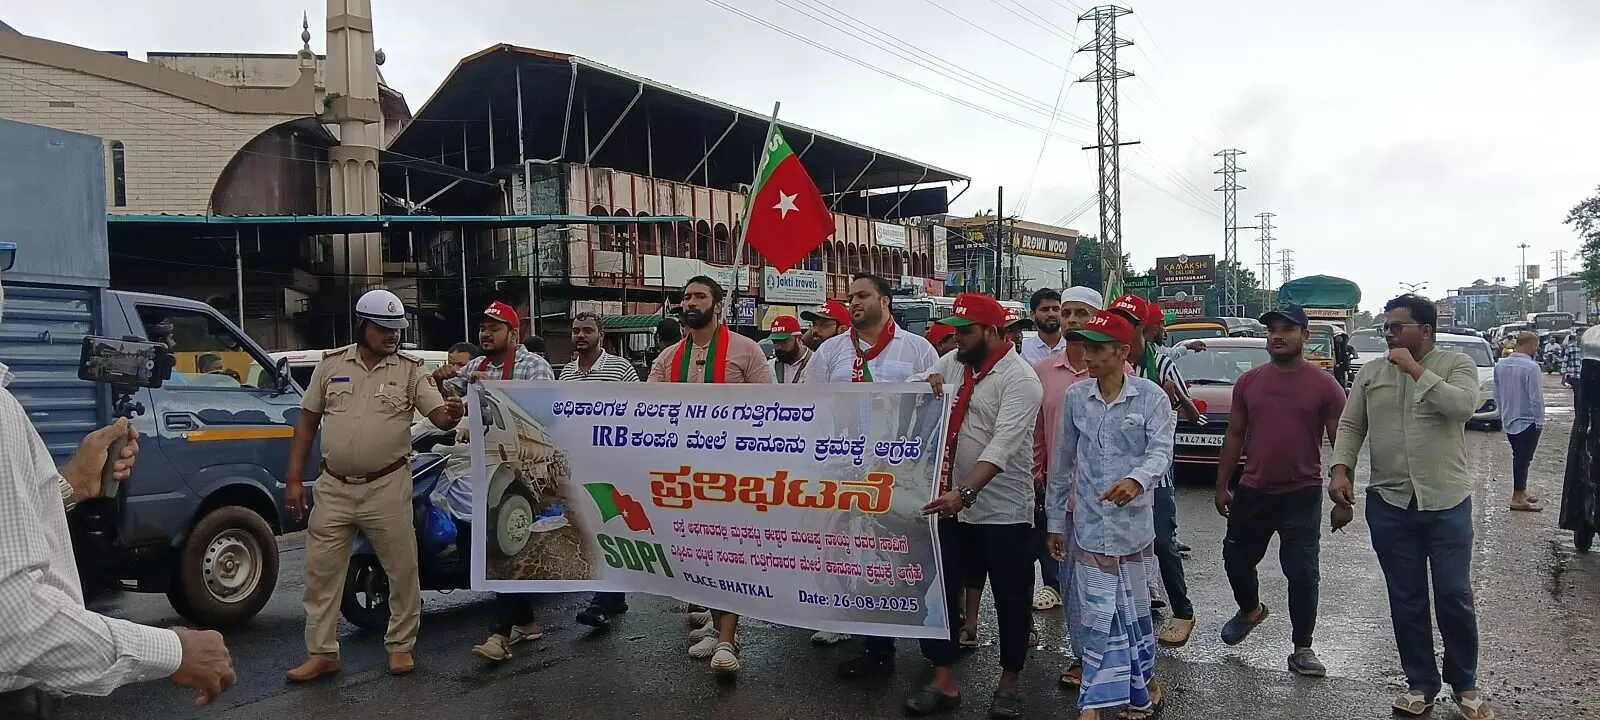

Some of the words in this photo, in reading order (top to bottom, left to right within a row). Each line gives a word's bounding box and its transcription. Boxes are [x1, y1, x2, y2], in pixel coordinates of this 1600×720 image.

[1022, 235, 1046, 251] BROWN
[1048, 239, 1068, 253] WOOD
[795, 278, 818, 289] travels
[1087, 316, 1108, 326] DPI
[552, 400, 628, 418] ಅಧಿಕಾರಿಗಳ
[685, 405, 708, 418] NH
[711, 406, 729, 419] 66
[732, 402, 815, 427] ಗುತ್ತಿಗೆದಾರ
[592, 426, 628, 447] IRB
[631, 429, 679, 448] ಕಂಪನಿ
[687, 430, 728, 450] ಮೇಲೆ
[735, 433, 806, 454] ಕಾನೂನು
[815, 435, 866, 465] ಕ್ರಮಕ್ಕೆ
[875, 437, 921, 464] ಆಗ್ರಹ
[1180, 436, 1190, 444] KA
[649, 465, 895, 514] ಪ್ರತಿಭಟನೆ
[597, 533, 674, 578] SDPI
[800, 556, 822, 572] ಮೇಲೆ
[825, 560, 862, 576] ಕಾನೂನು
[683, 571, 717, 588] PLACE:
[719, 579, 774, 598] BHATKAL
[798, 589, 829, 606] Date:
[833, 593, 919, 612] 26-08-2025
